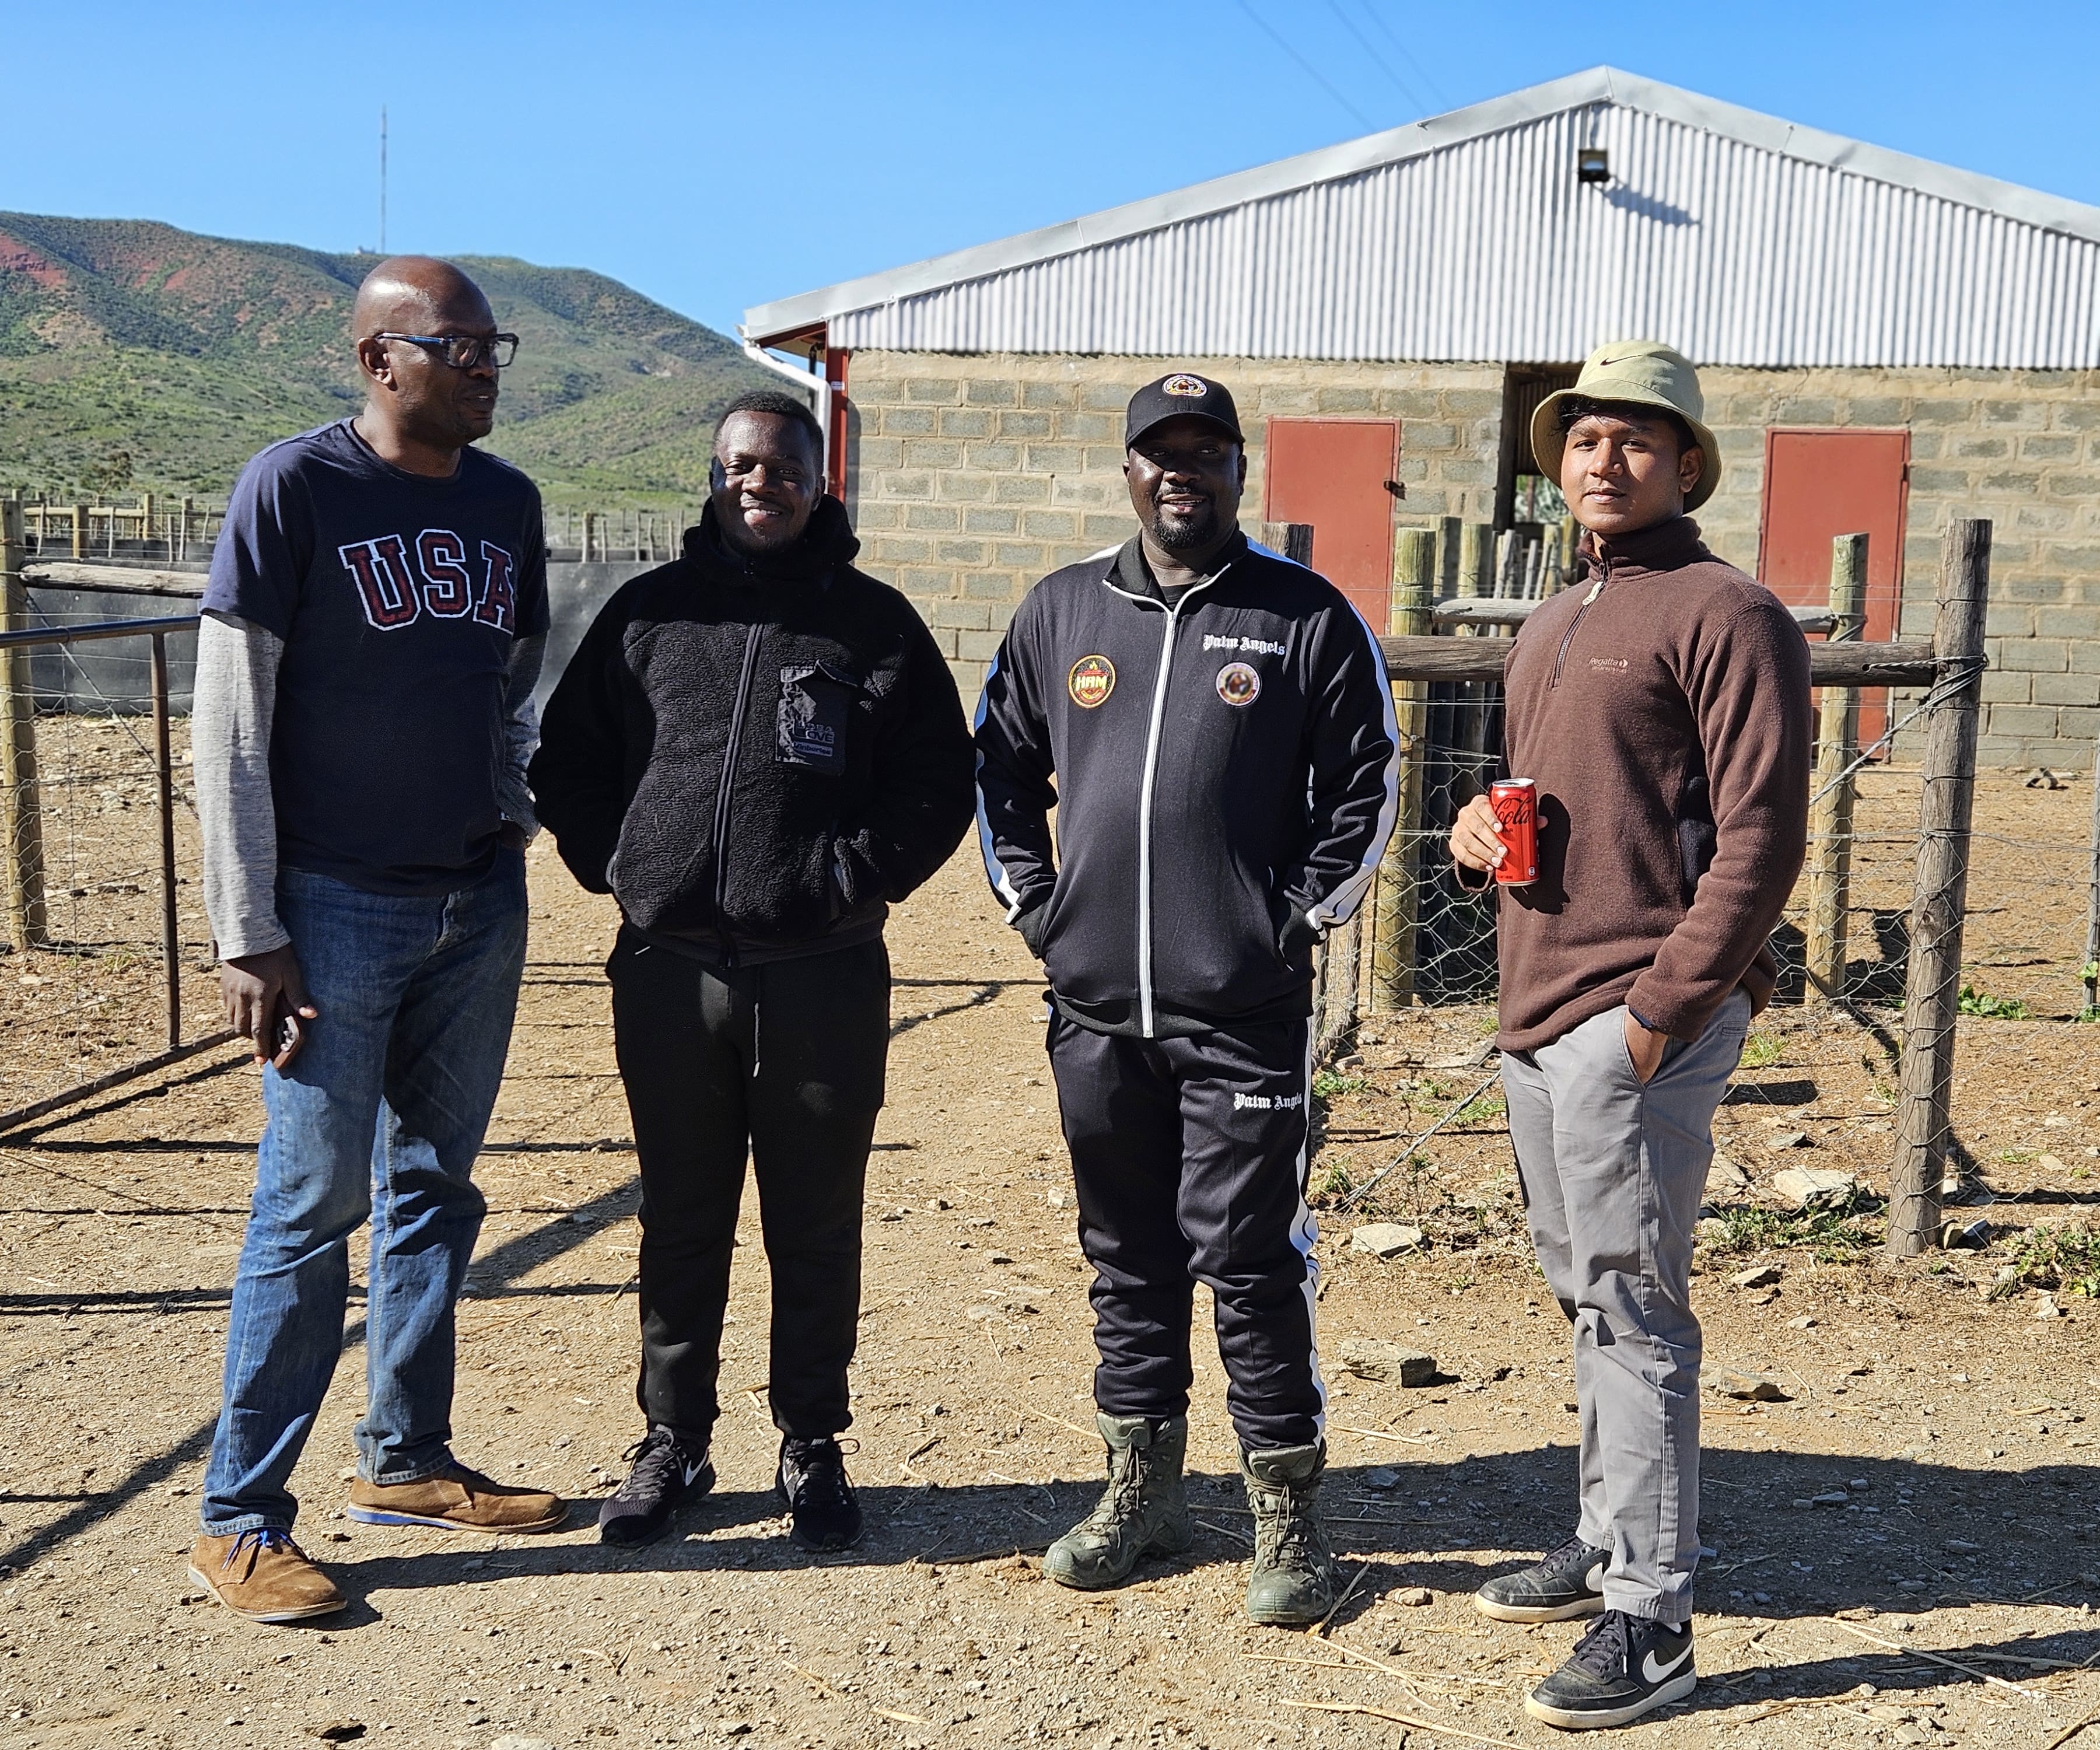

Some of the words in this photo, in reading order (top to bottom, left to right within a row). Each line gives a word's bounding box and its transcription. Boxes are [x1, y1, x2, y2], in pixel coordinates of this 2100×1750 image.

[337, 528, 515, 635] USA
[1203, 634, 1239, 651] Palm
[1240, 636, 1286, 655] Angels
[1075, 675, 1107, 692] HAM
[1494, 796, 1533, 827] Cola
[1234, 1092, 1272, 1111] Palm
[1273, 1091, 1303, 1111] Angels
